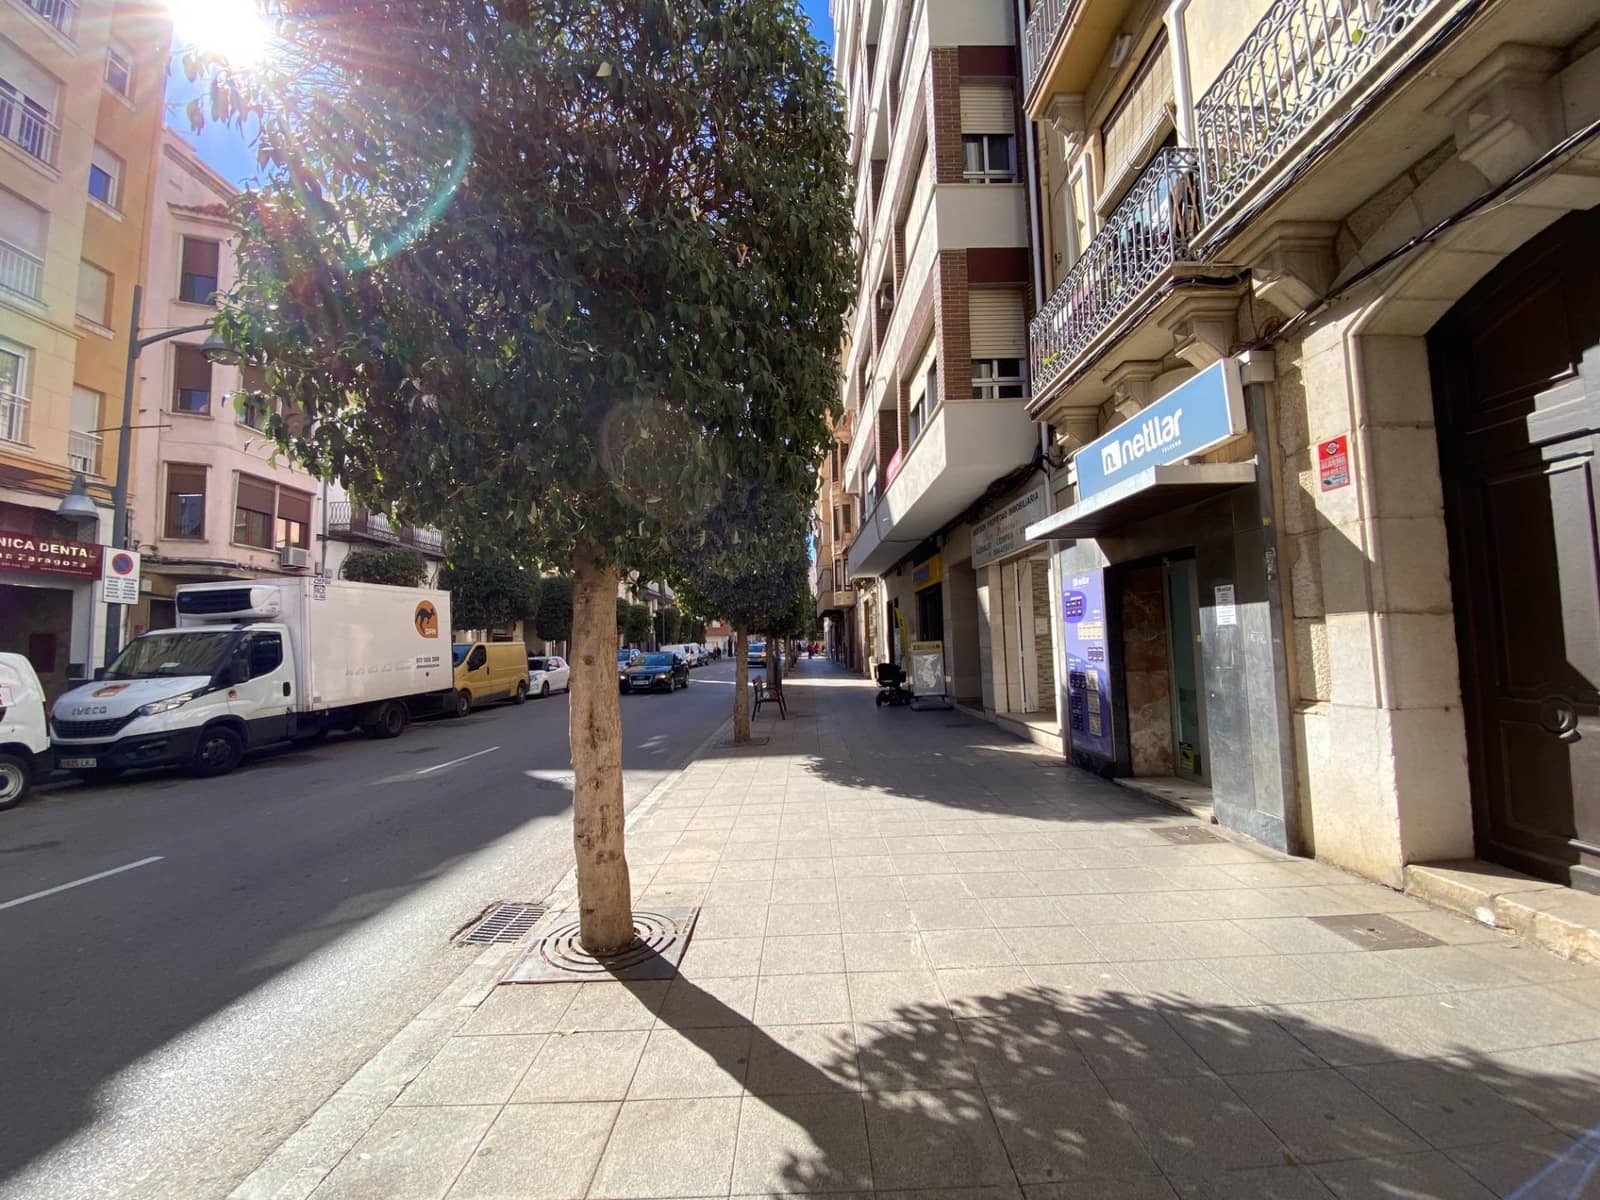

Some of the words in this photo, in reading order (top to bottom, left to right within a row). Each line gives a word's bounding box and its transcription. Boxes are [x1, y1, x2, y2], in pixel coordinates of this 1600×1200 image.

[1122, 408, 1183, 465] netllar
[39, 542, 96, 559] DENTAL
[18, 553, 87, 568] Zaragoza
[72, 706, 107, 716] IVECO
